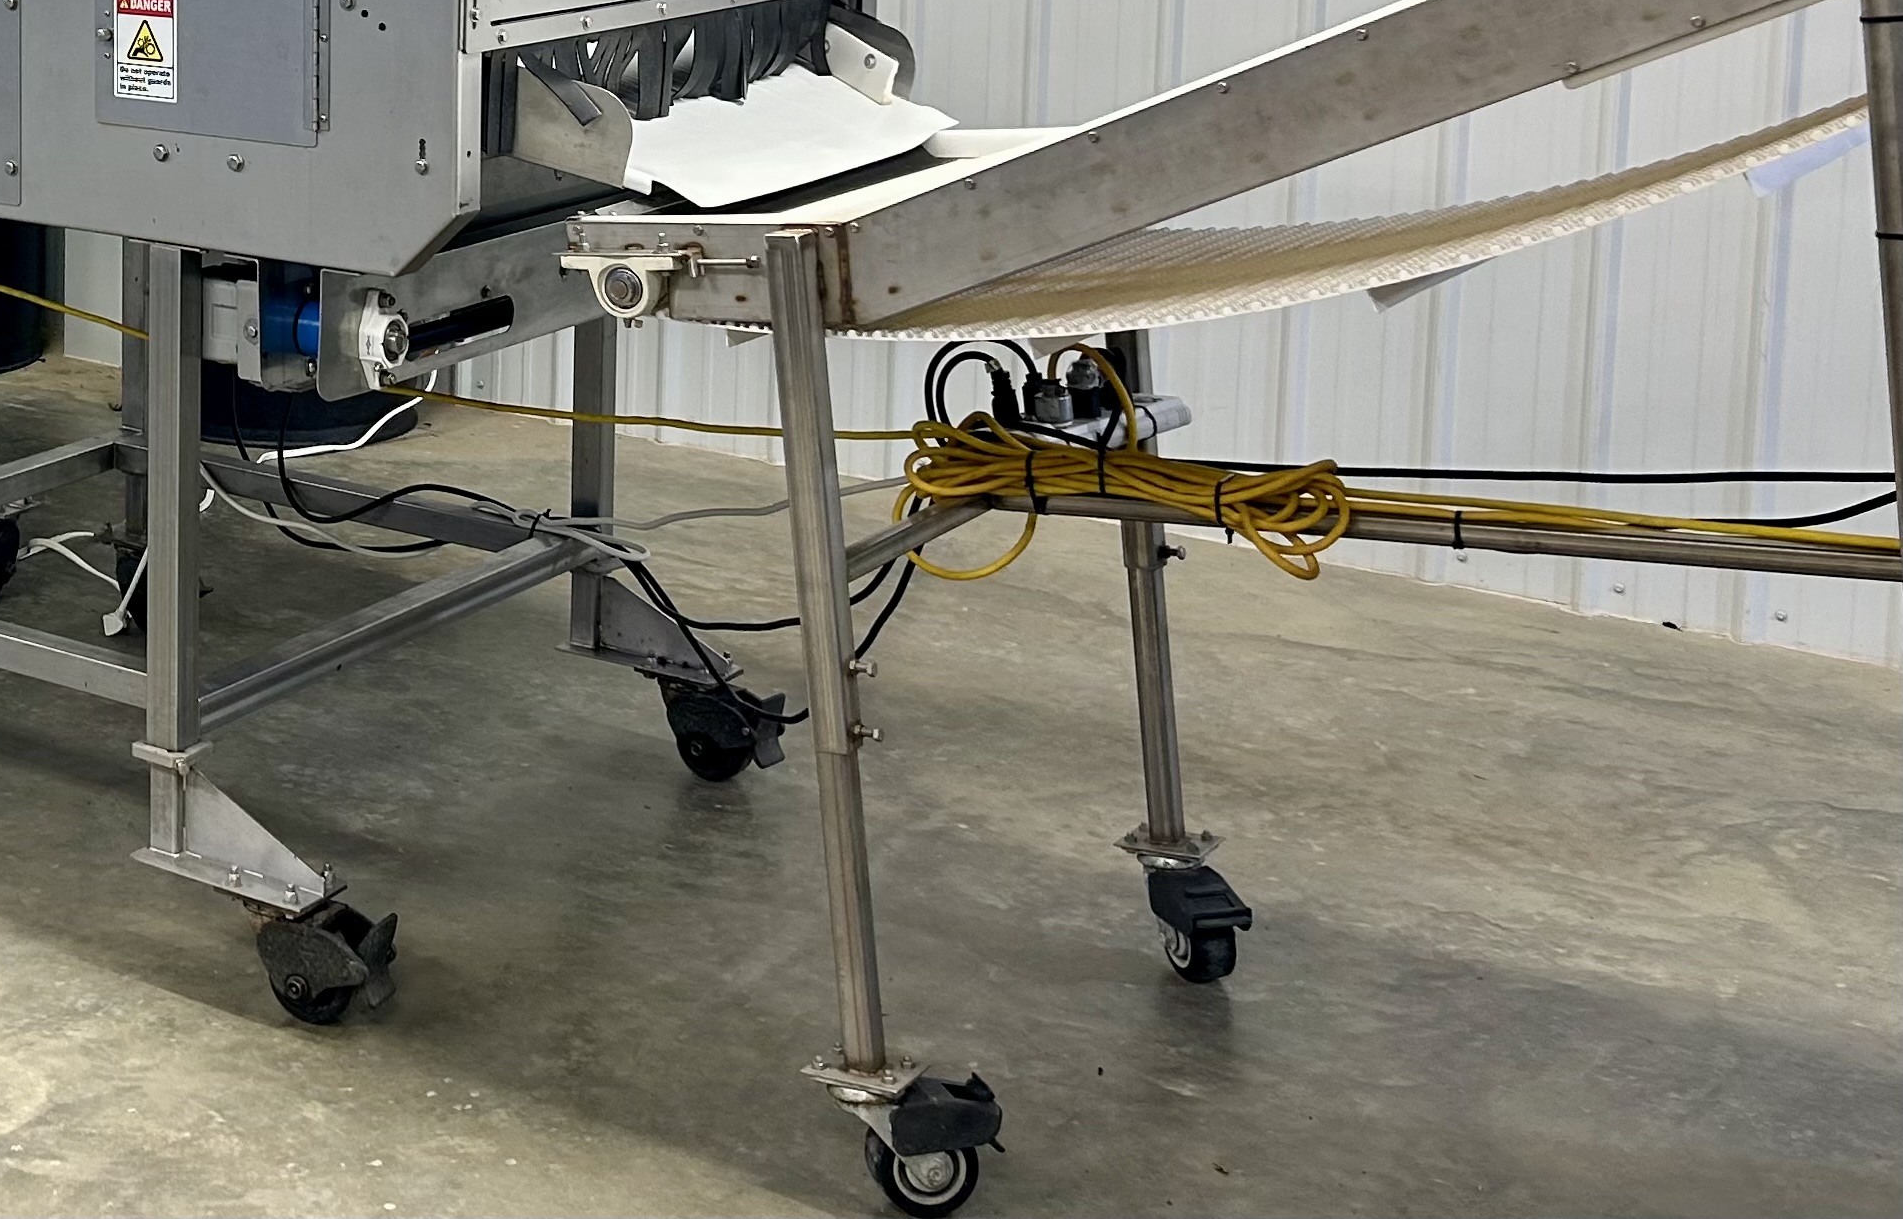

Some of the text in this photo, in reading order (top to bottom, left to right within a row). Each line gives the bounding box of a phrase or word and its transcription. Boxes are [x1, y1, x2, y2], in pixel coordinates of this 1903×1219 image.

[119, 65, 129, 73] Do
[143, 69, 171, 77] operate
[119, 75, 146, 83] without
